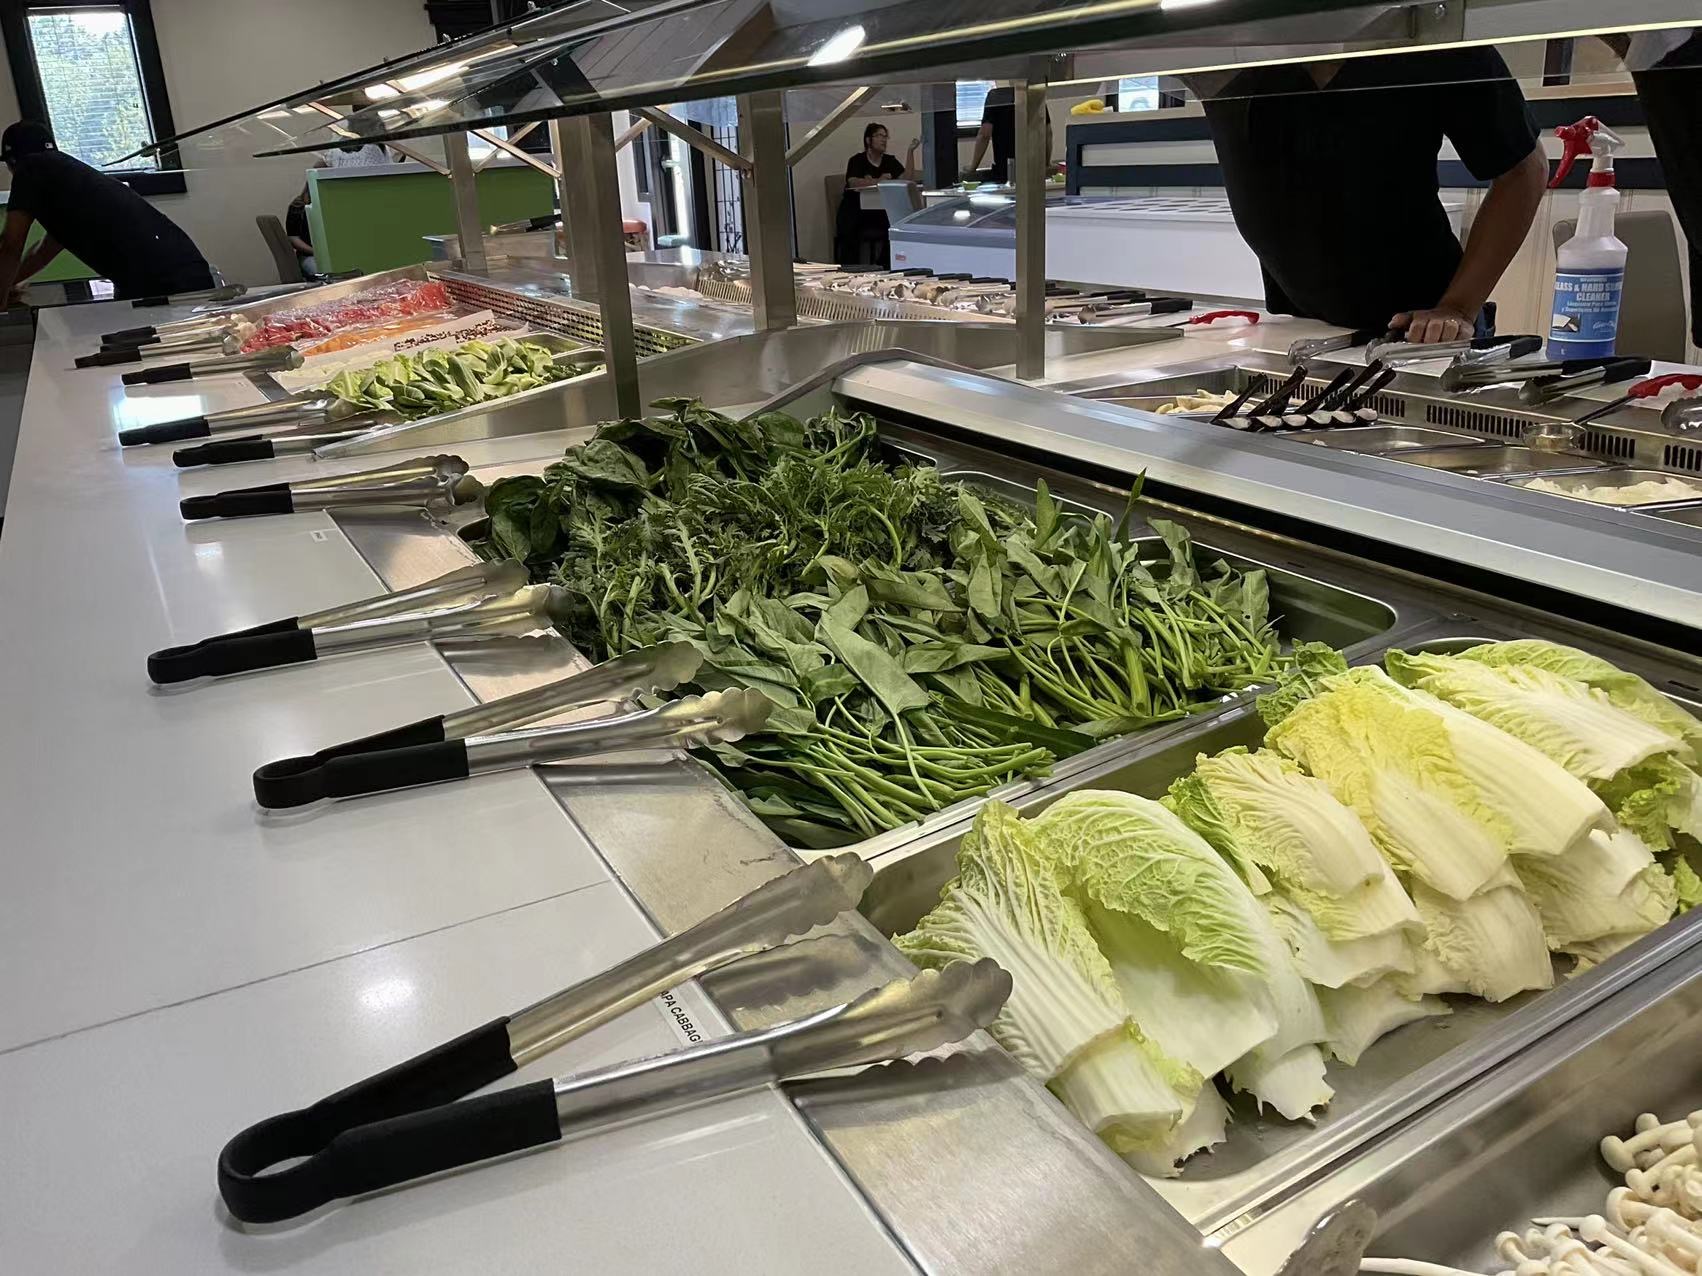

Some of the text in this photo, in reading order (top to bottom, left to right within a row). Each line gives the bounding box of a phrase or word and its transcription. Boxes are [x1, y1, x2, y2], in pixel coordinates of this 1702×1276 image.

[1581, 282, 1604, 292] HARD
[1576, 292, 1610, 301] CLEANER
[671, 1007, 703, 1043] CABBAG
